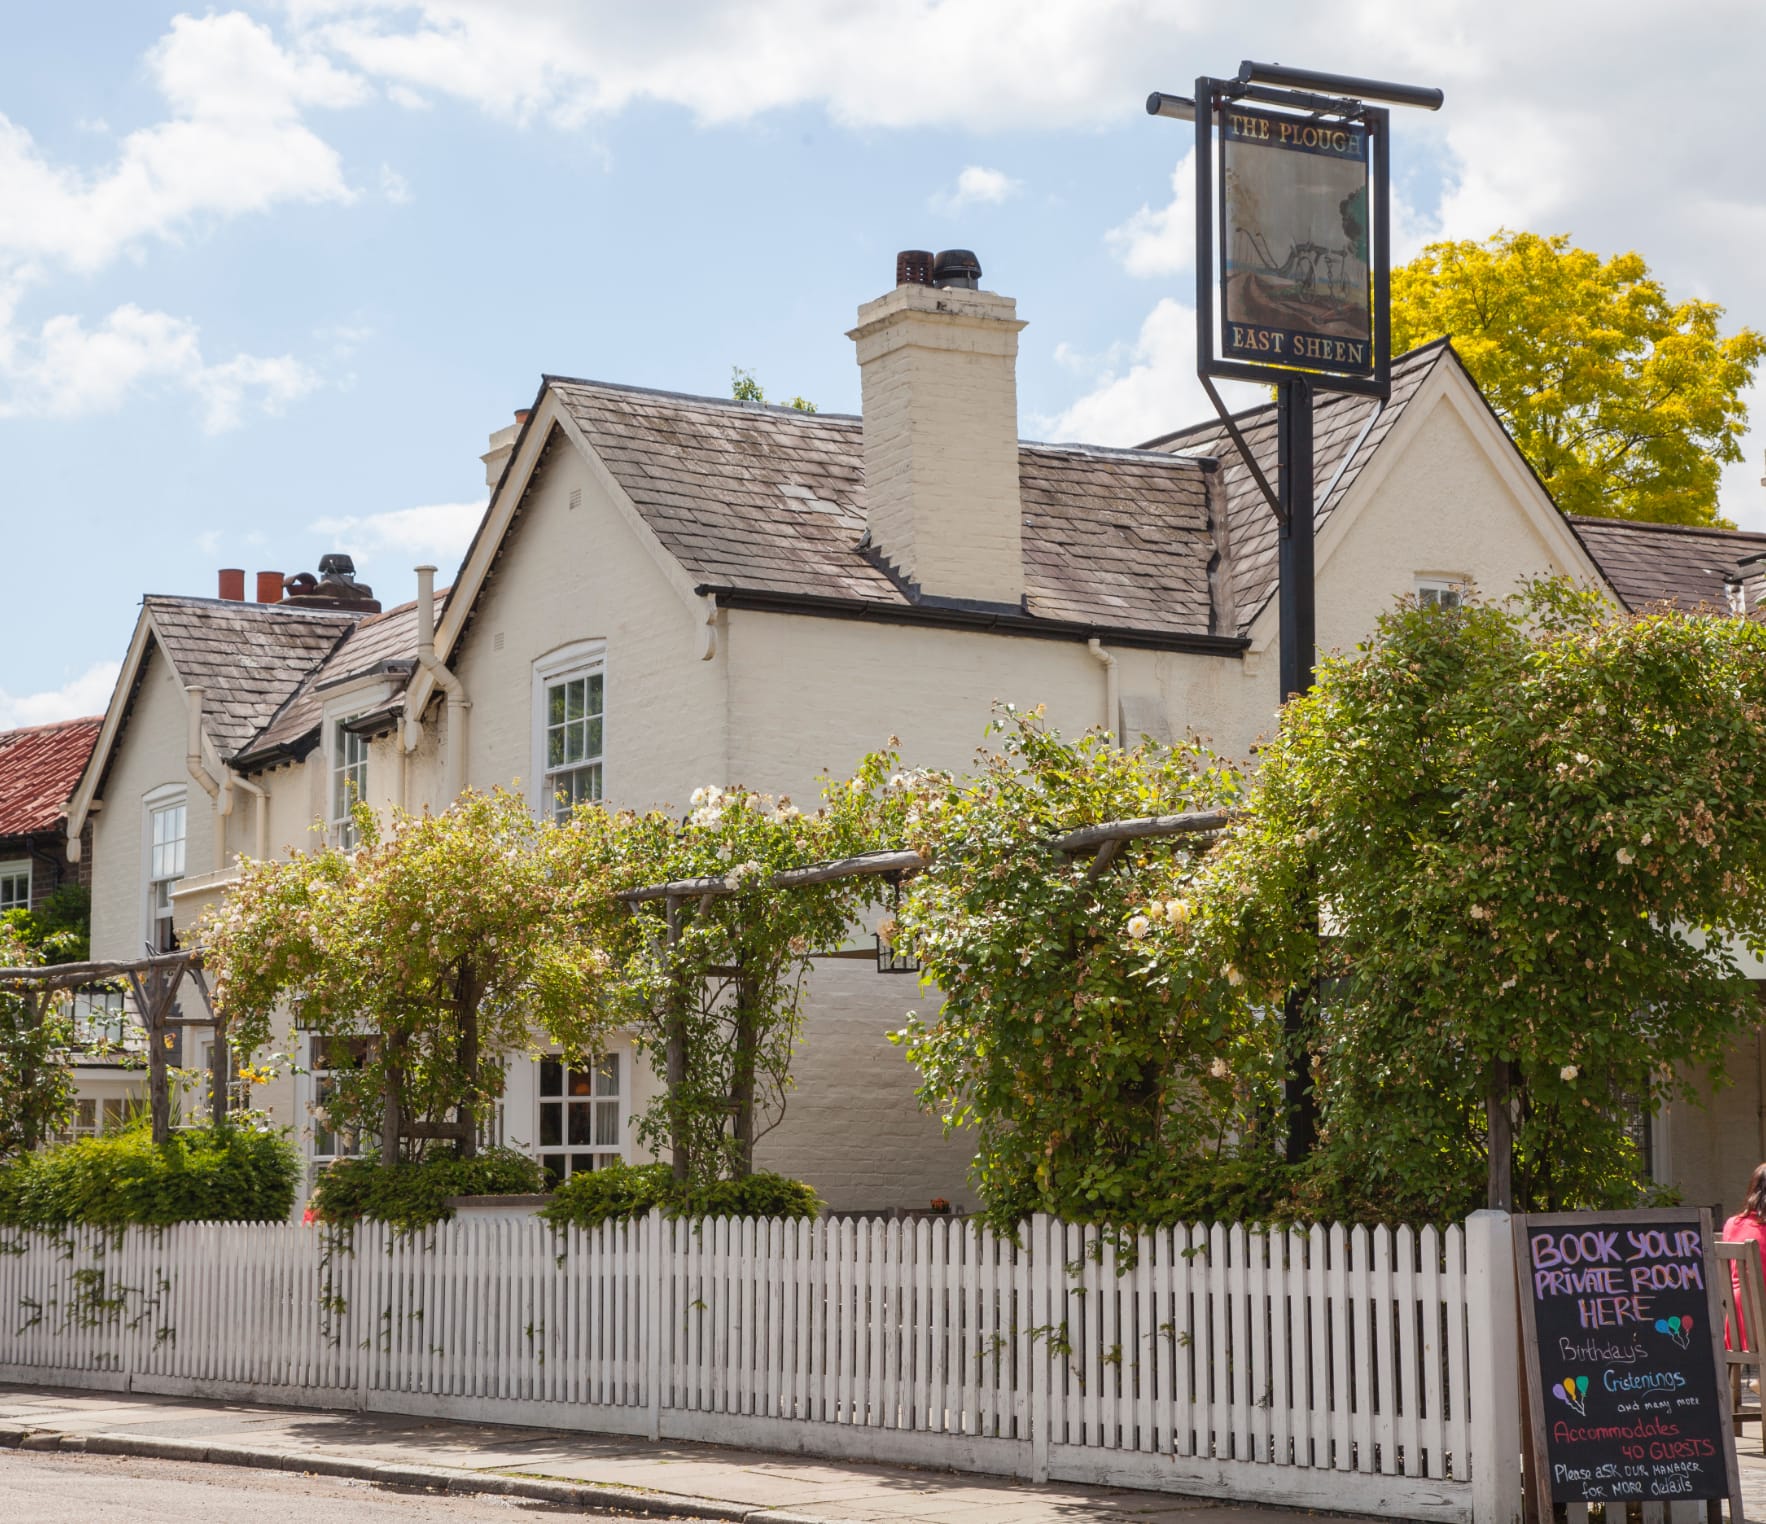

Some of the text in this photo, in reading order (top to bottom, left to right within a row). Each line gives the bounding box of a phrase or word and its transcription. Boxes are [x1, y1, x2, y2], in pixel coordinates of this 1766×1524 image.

[1230, 114, 1362, 156] THE PLOUGH
[1232, 326, 1364, 364] EAST SHEEN
[1531, 1229, 1702, 1269] BOOK YOUR
[1631, 1263, 1703, 1293] ROOM
[1578, 1295, 1657, 1329] HERE
[1617, 1403, 1640, 1412] and
[1644, 1401, 1672, 1414] many
[1553, 1416, 1680, 1444] Accommodates
[1622, 1444, 1645, 1460] 40
[1554, 1464, 1593, 1483] Please
[1652, 1477, 1693, 1495] details
